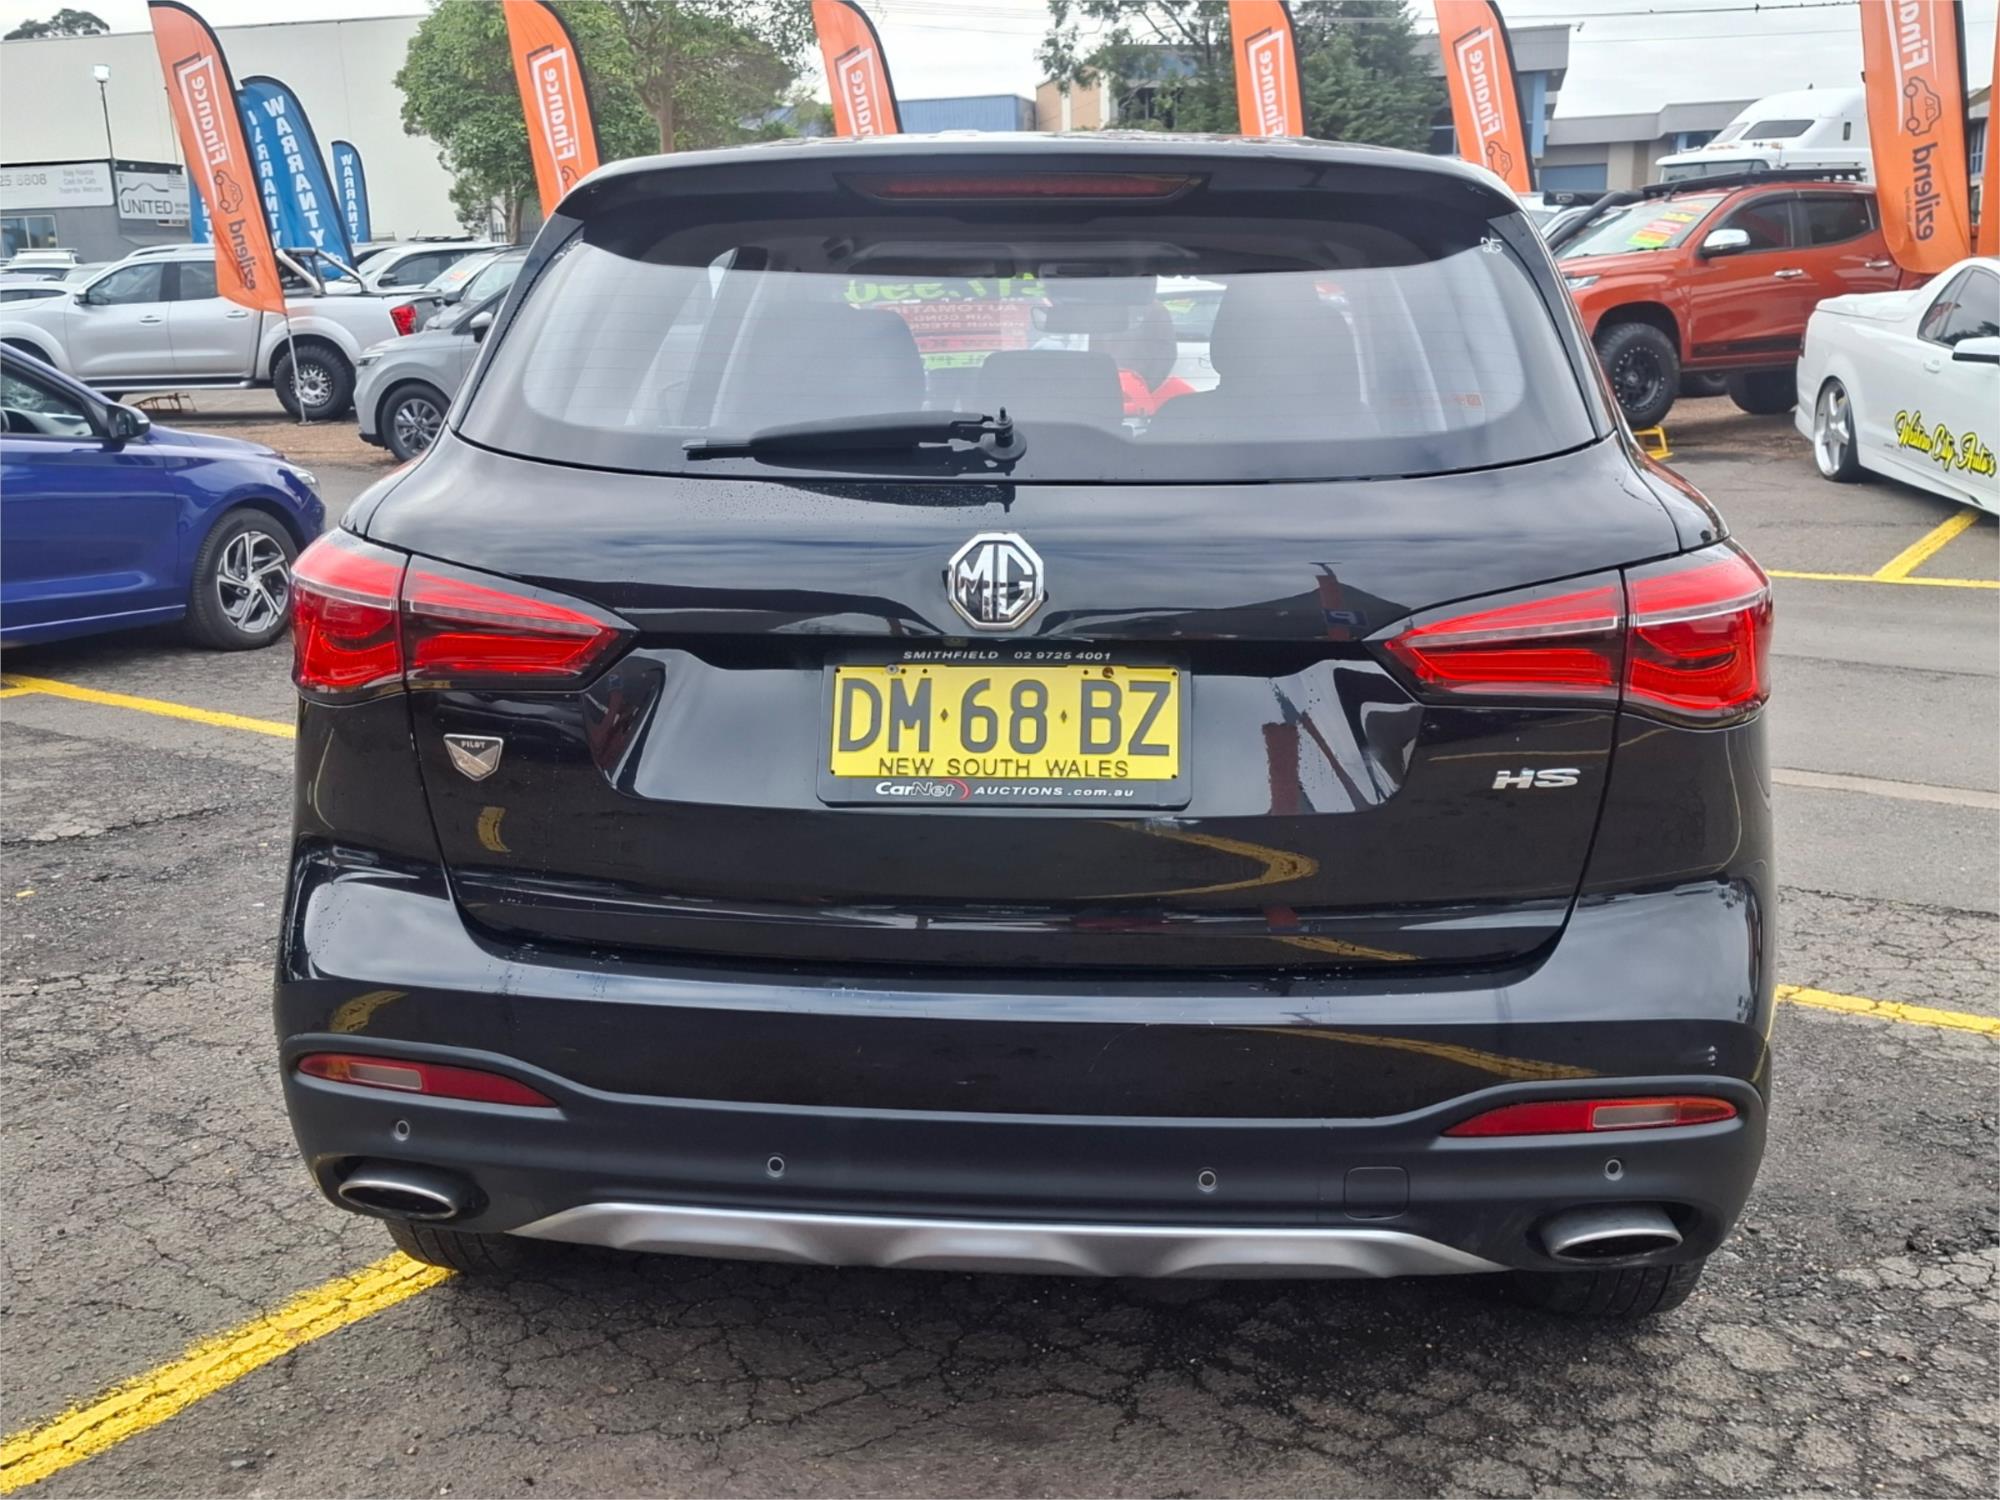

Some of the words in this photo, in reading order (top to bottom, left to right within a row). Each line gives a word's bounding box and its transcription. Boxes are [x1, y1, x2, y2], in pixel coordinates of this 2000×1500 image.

[957, 543, 1033, 620] MG
[903, 650, 999, 660] SMITHFIELD
[1014, 650, 1032, 660] 02
[1035, 650, 1073, 661] 9725
[1075, 651, 1111, 661] 4001
[838, 677, 933, 753] DM
[960, 678, 1048, 755] 68
[1079, 679, 1172, 757] BZ
[461, 740, 486, 749] PILOT
[879, 758, 933, 776] NEW
[947, 758, 1030, 777] SOUTH
[1046, 759, 1128, 778] WALES
[1492, 768, 1581, 789] HS
[875, 781, 955, 797] CarNet
